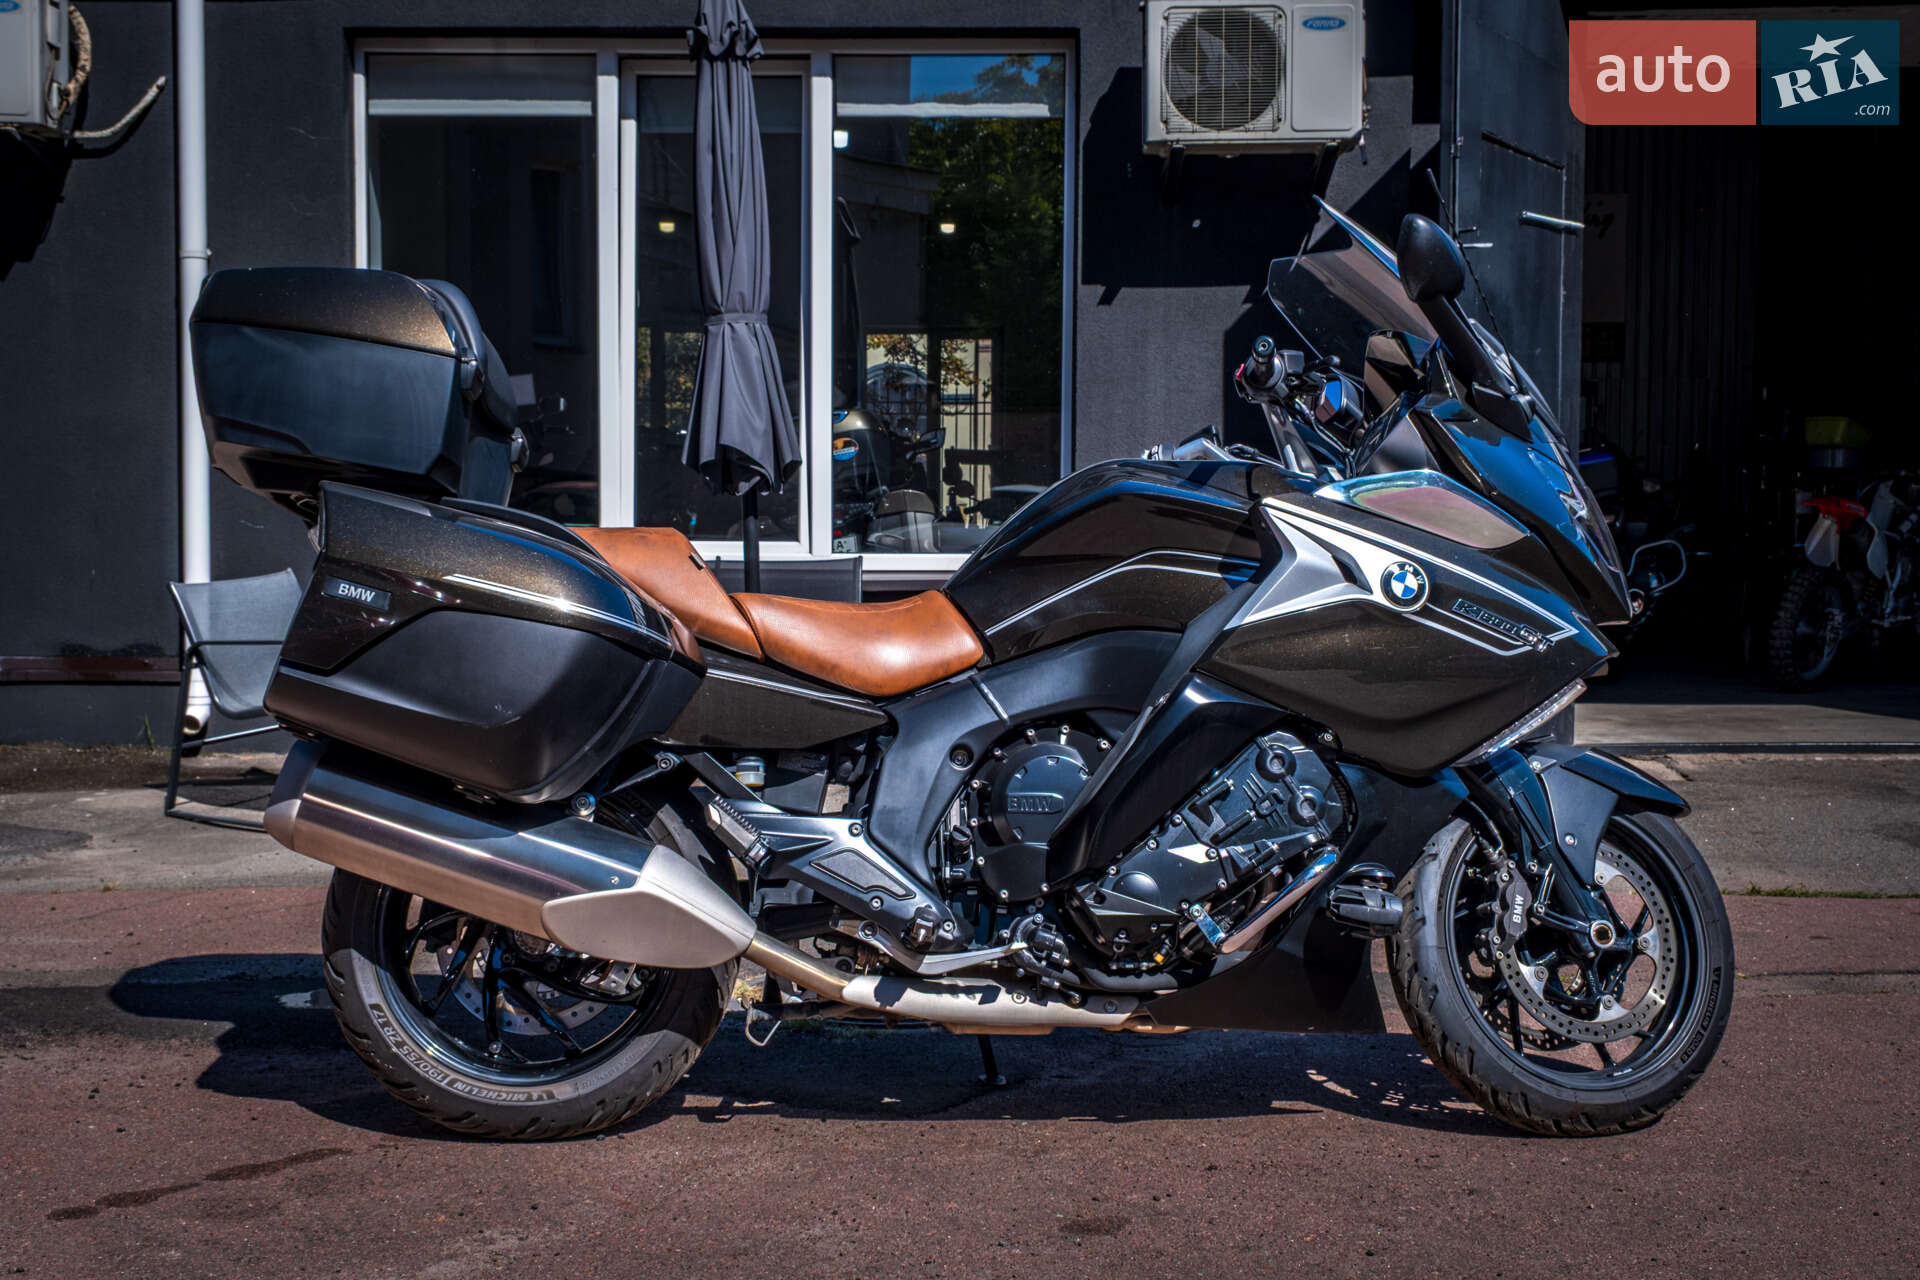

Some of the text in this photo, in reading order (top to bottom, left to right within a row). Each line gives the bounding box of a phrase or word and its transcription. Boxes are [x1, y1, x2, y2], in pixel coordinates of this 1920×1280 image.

[338, 583, 376, 602] BMW
[1008, 797, 1051, 812] BMW
[1512, 894, 1524, 923] BMW
[373, 1007, 526, 1101] MICHELIN 190/55 ZR 17
